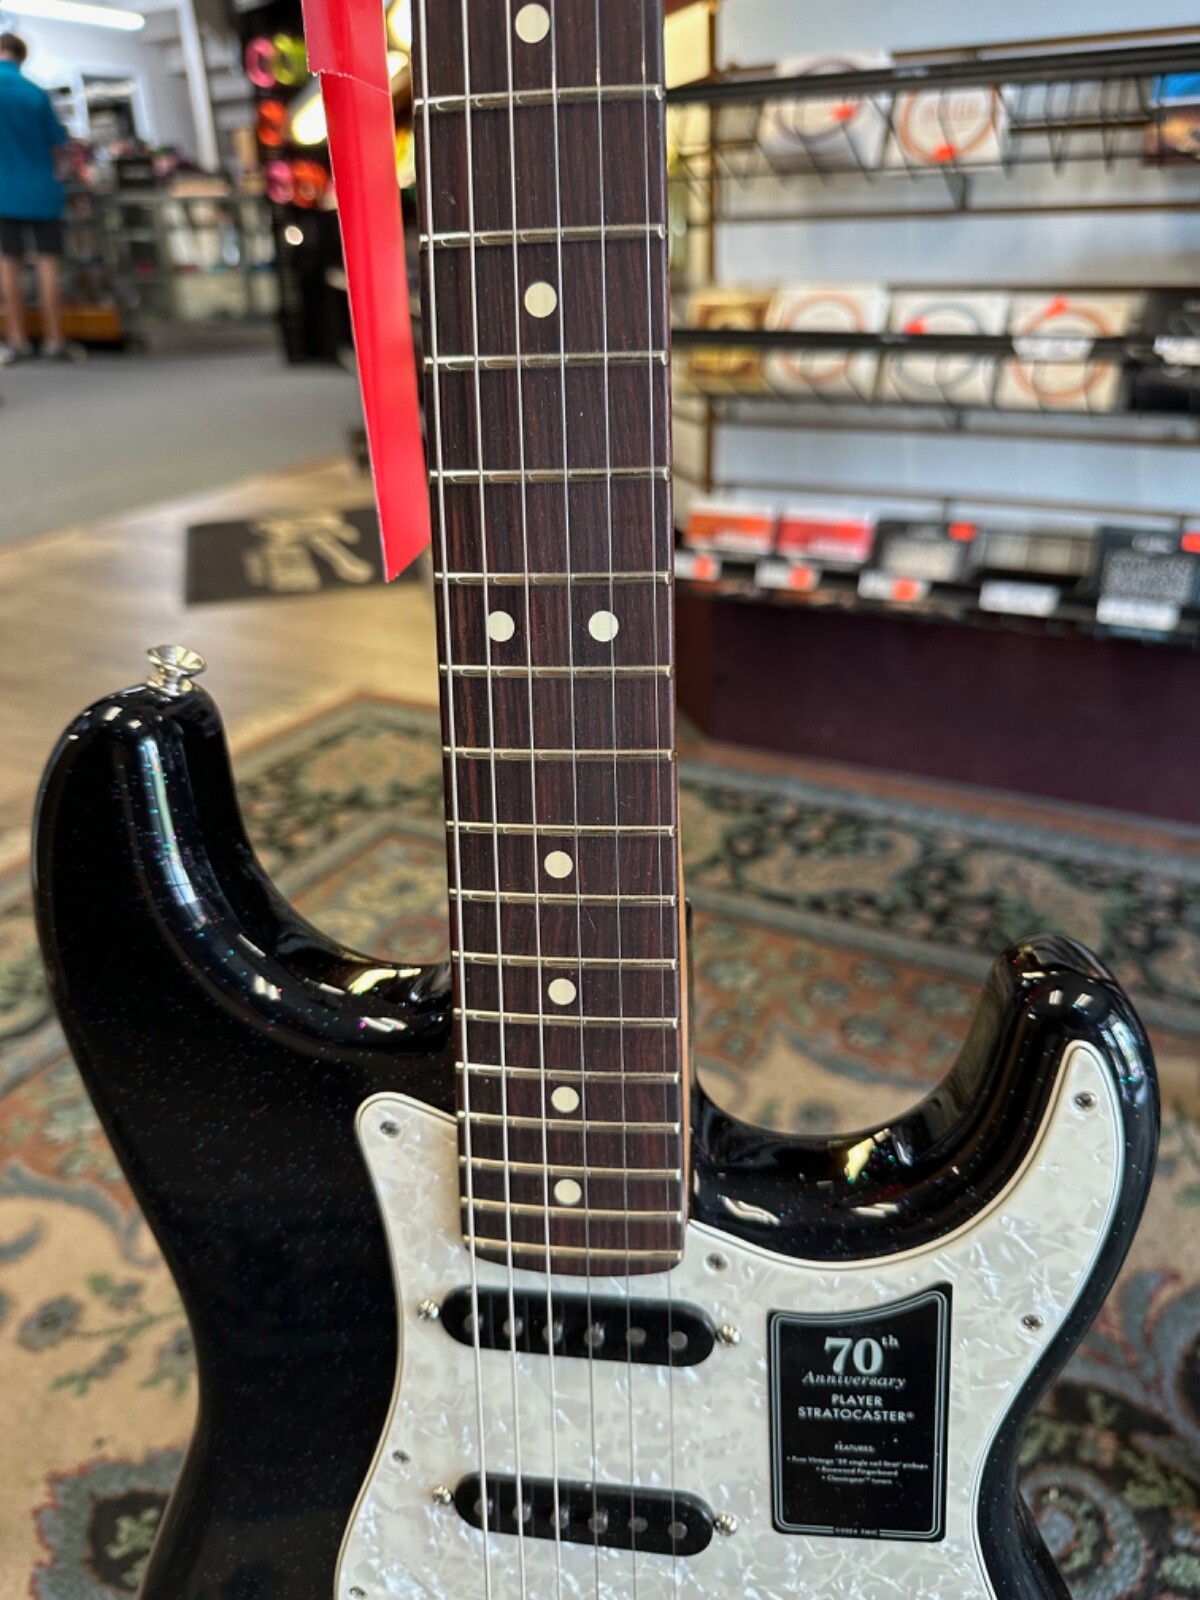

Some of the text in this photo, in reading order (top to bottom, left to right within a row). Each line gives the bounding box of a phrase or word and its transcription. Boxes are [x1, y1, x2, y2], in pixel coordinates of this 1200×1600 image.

[824, 1335, 900, 1374] 70th
[802, 1371, 907, 1388] Anniversary
[831, 1393, 883, 1407] PLAYER
